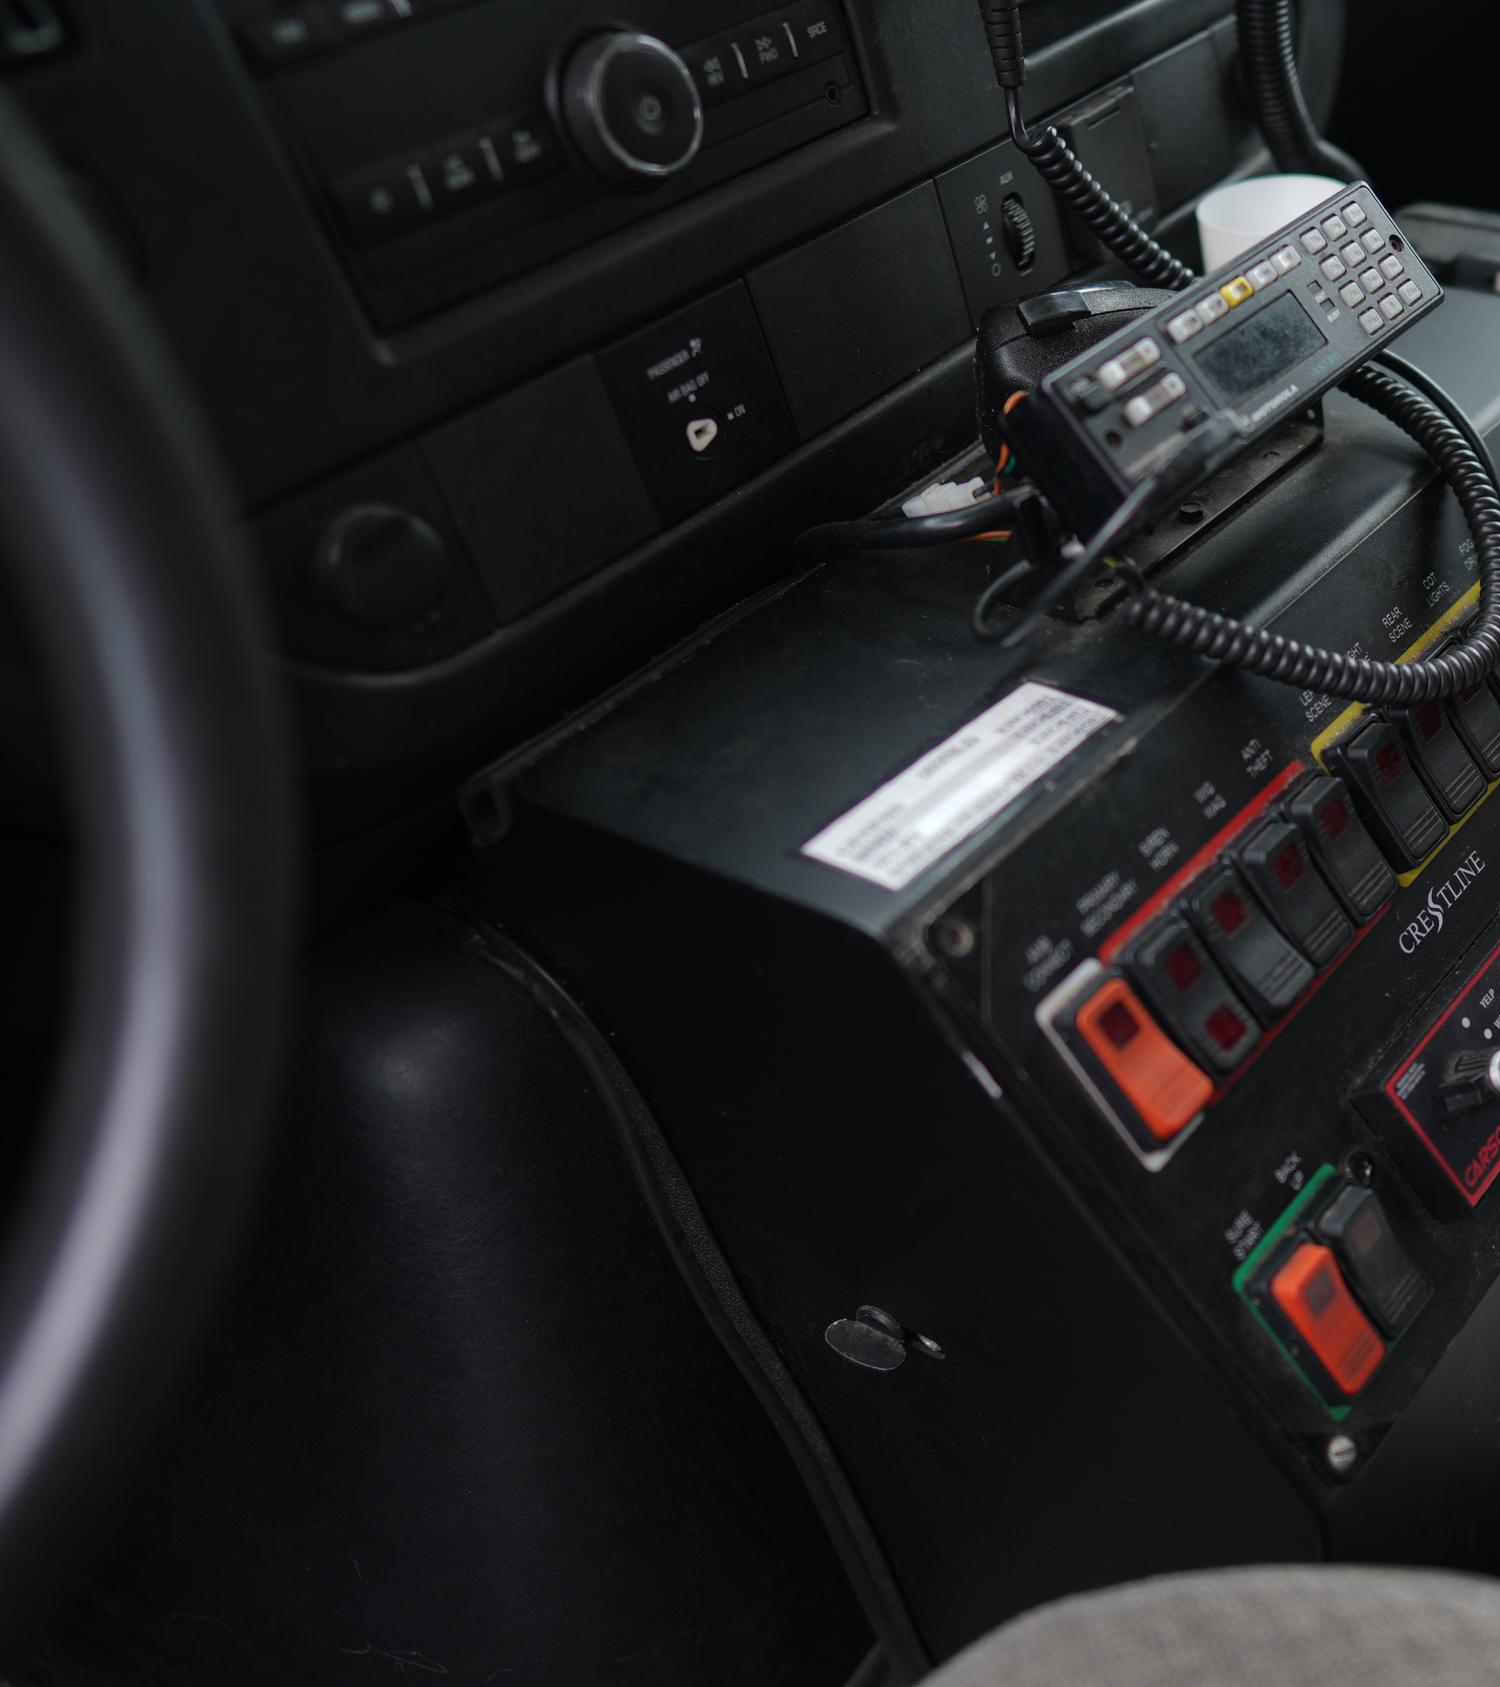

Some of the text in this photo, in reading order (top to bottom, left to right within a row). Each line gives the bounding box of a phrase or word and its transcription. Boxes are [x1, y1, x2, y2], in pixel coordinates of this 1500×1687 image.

[1422, 571, 1439, 590] COT
[1426, 581, 1450, 607] LIGHTS
[1381, 606, 1403, 629] REAR
[1388, 617, 1412, 643] SCENE
[1305, 694, 1332, 722] SCENE
[1241, 739, 1261, 761] ANTI
[1246, 749, 1273, 777] THEFT
[1138, 825, 1170, 858] SIREN
[1150, 840, 1179, 871] HORN
[1479, 988, 1496, 1009] YELP
[1274, 1151, 1302, 1184] BACK
[1288, 1170, 1304, 1191] UP
[1224, 1209, 1254, 1245] SURE
[1232, 1220, 1264, 1261] START
